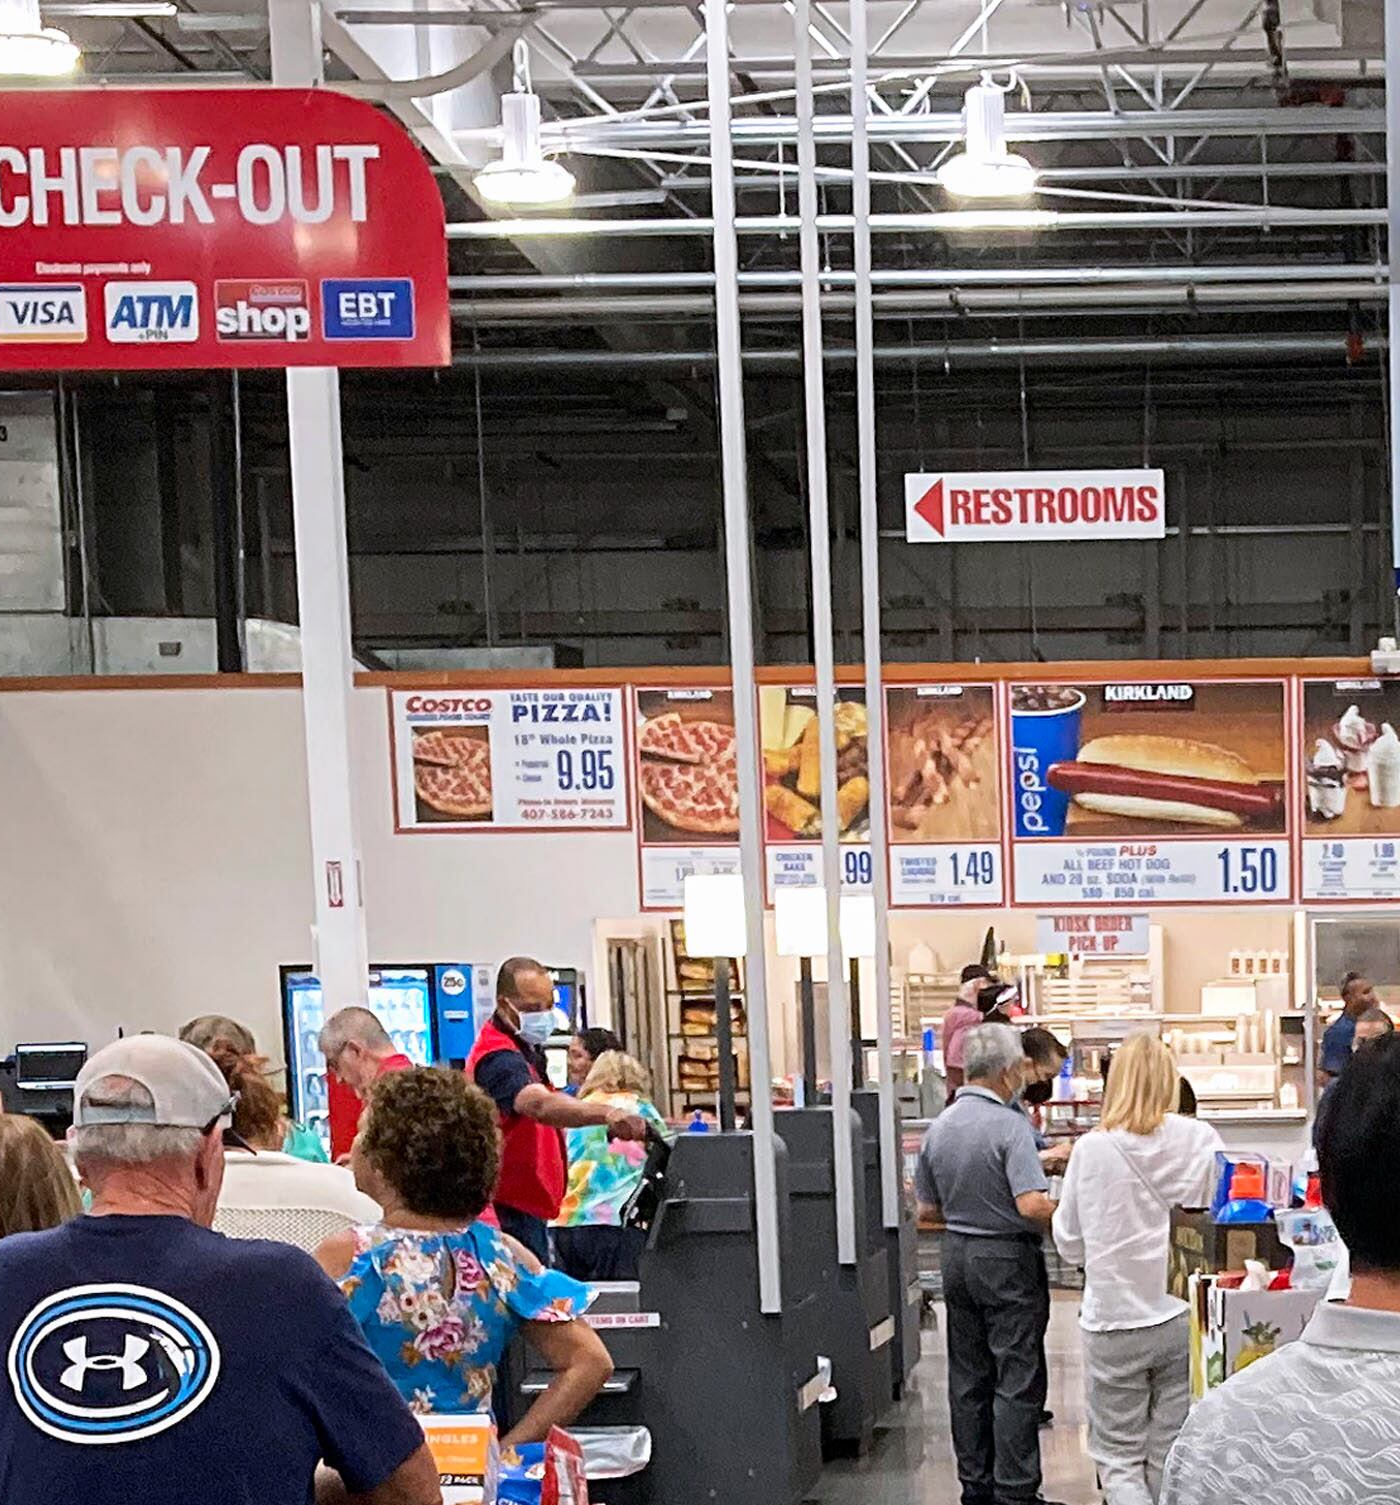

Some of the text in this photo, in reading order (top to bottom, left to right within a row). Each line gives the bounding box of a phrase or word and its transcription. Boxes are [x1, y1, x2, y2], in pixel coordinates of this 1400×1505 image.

[7, 301, 74, 325] VISA
[111, 295, 193, 328] ATM
[339, 291, 396, 319] EBT
[217, 301, 309, 342] shop
[950, 486, 1158, 525] RESTROOMS
[1105, 685, 1192, 701] KIRKLAND
[512, 703, 611, 723] PIZZA!
[540, 734, 576, 745] Whole
[581, 733, 613, 745] Pizza
[557, 750, 614, 790] 9.95
[1013, 748, 1048, 831] pepsi
[1063, 860, 1083, 870] ALL
[1088, 859, 1114, 870] BEEF
[1119, 859, 1142, 870] HOT
[1119, 846, 1157, 857] PLUS
[840, 851, 872, 884] .99
[950, 851, 994, 885] 1.49
[1218, 848, 1277, 892] 1.50
[1054, 915, 1132, 932] KIOSK ORDER
